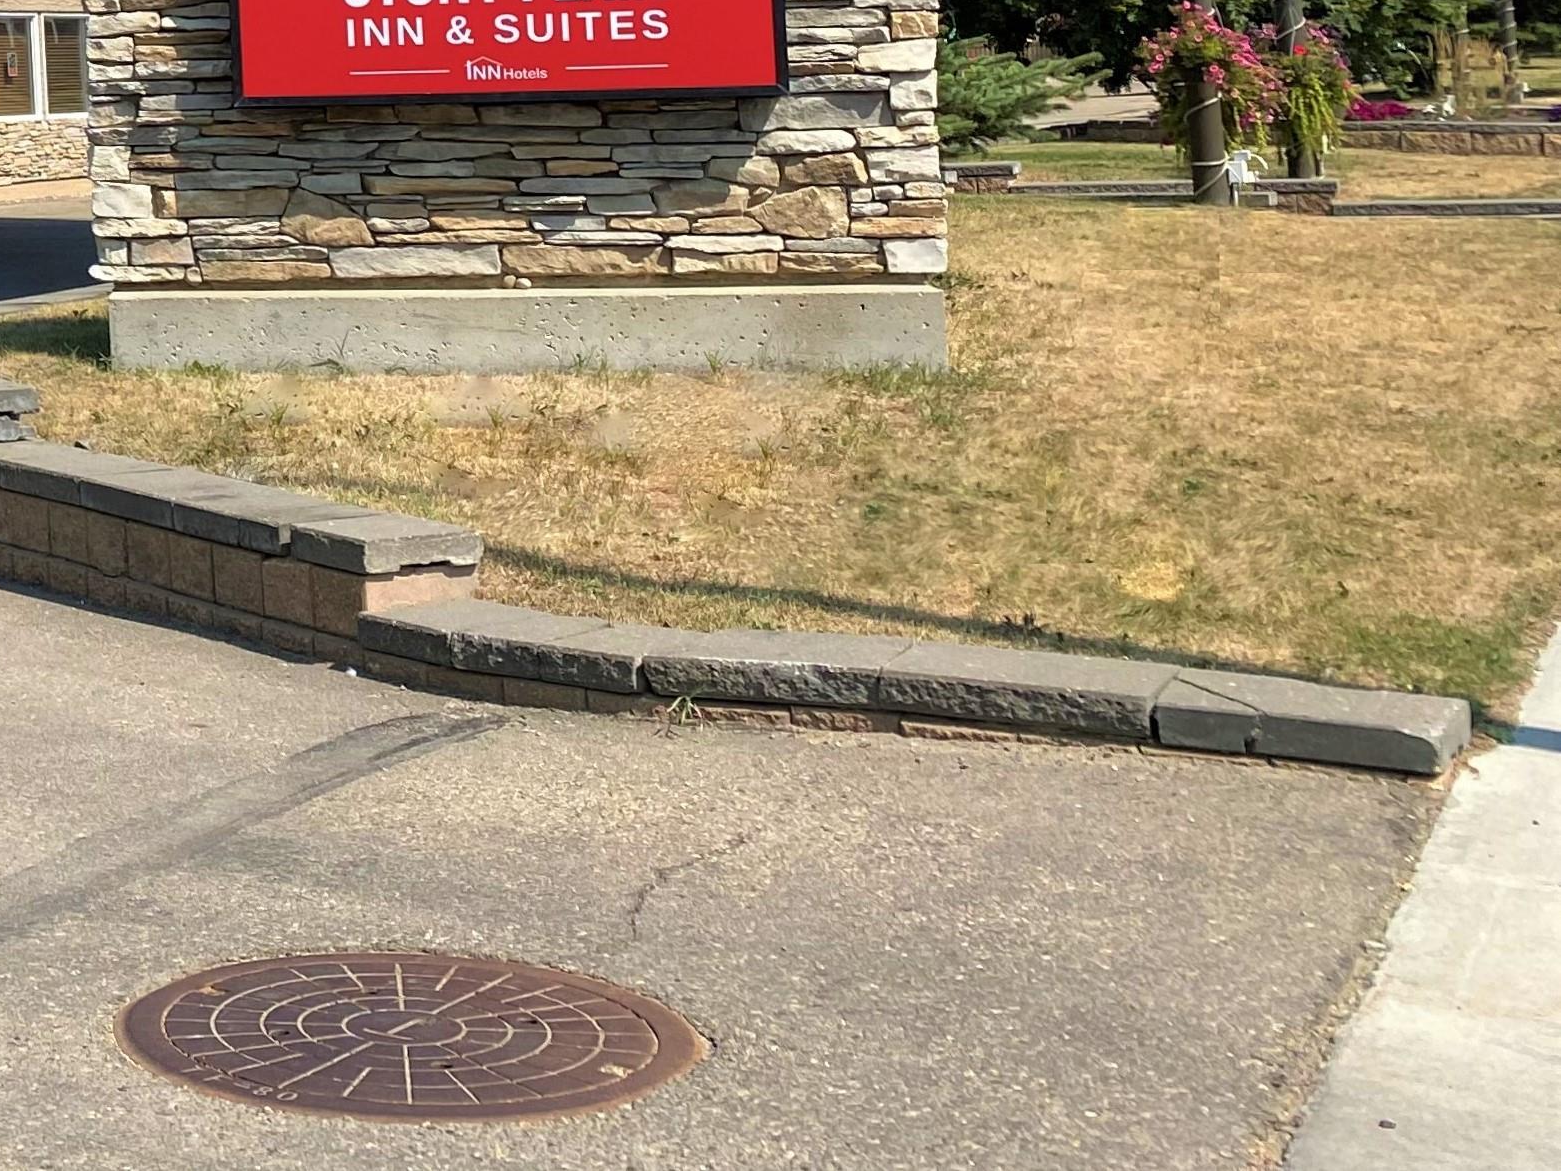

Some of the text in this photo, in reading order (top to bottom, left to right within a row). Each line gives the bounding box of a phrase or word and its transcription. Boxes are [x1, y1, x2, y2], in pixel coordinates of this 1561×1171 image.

[346, 9, 669, 47] INN & SUITES
[466, 59, 548, 80] INN Hotels
